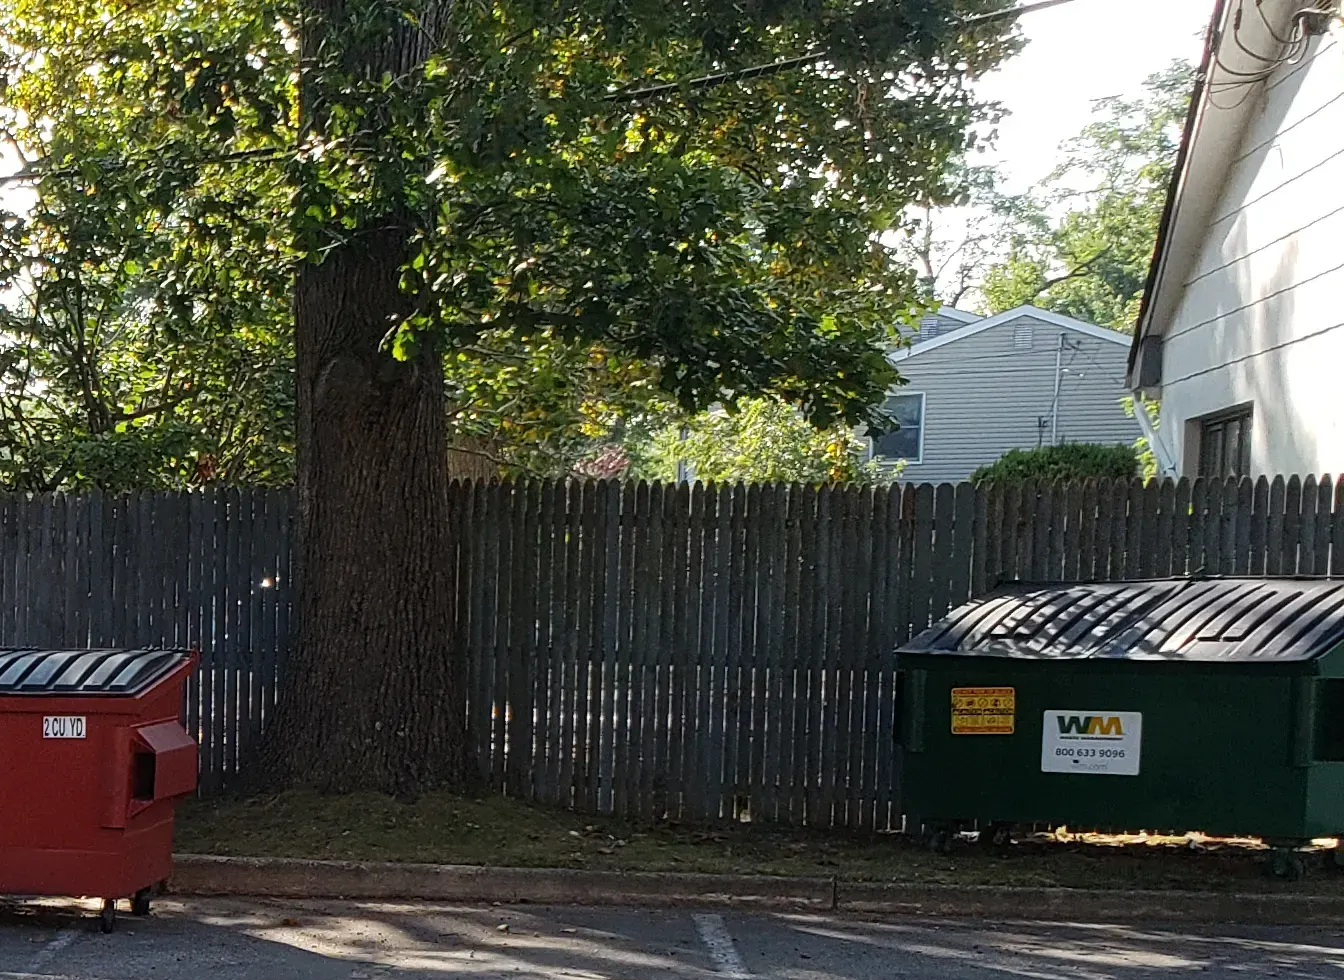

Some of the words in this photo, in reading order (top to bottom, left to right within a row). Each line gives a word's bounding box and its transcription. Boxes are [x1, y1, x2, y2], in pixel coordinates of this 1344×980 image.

[44, 718, 49, 736] 2
[69, 718, 85, 737] YD.
[1056, 715, 1123, 735] WM
[1055, 748, 1074, 756] 800
[1076, 748, 1096, 757] 633
[1098, 749, 1125, 758] 9096
